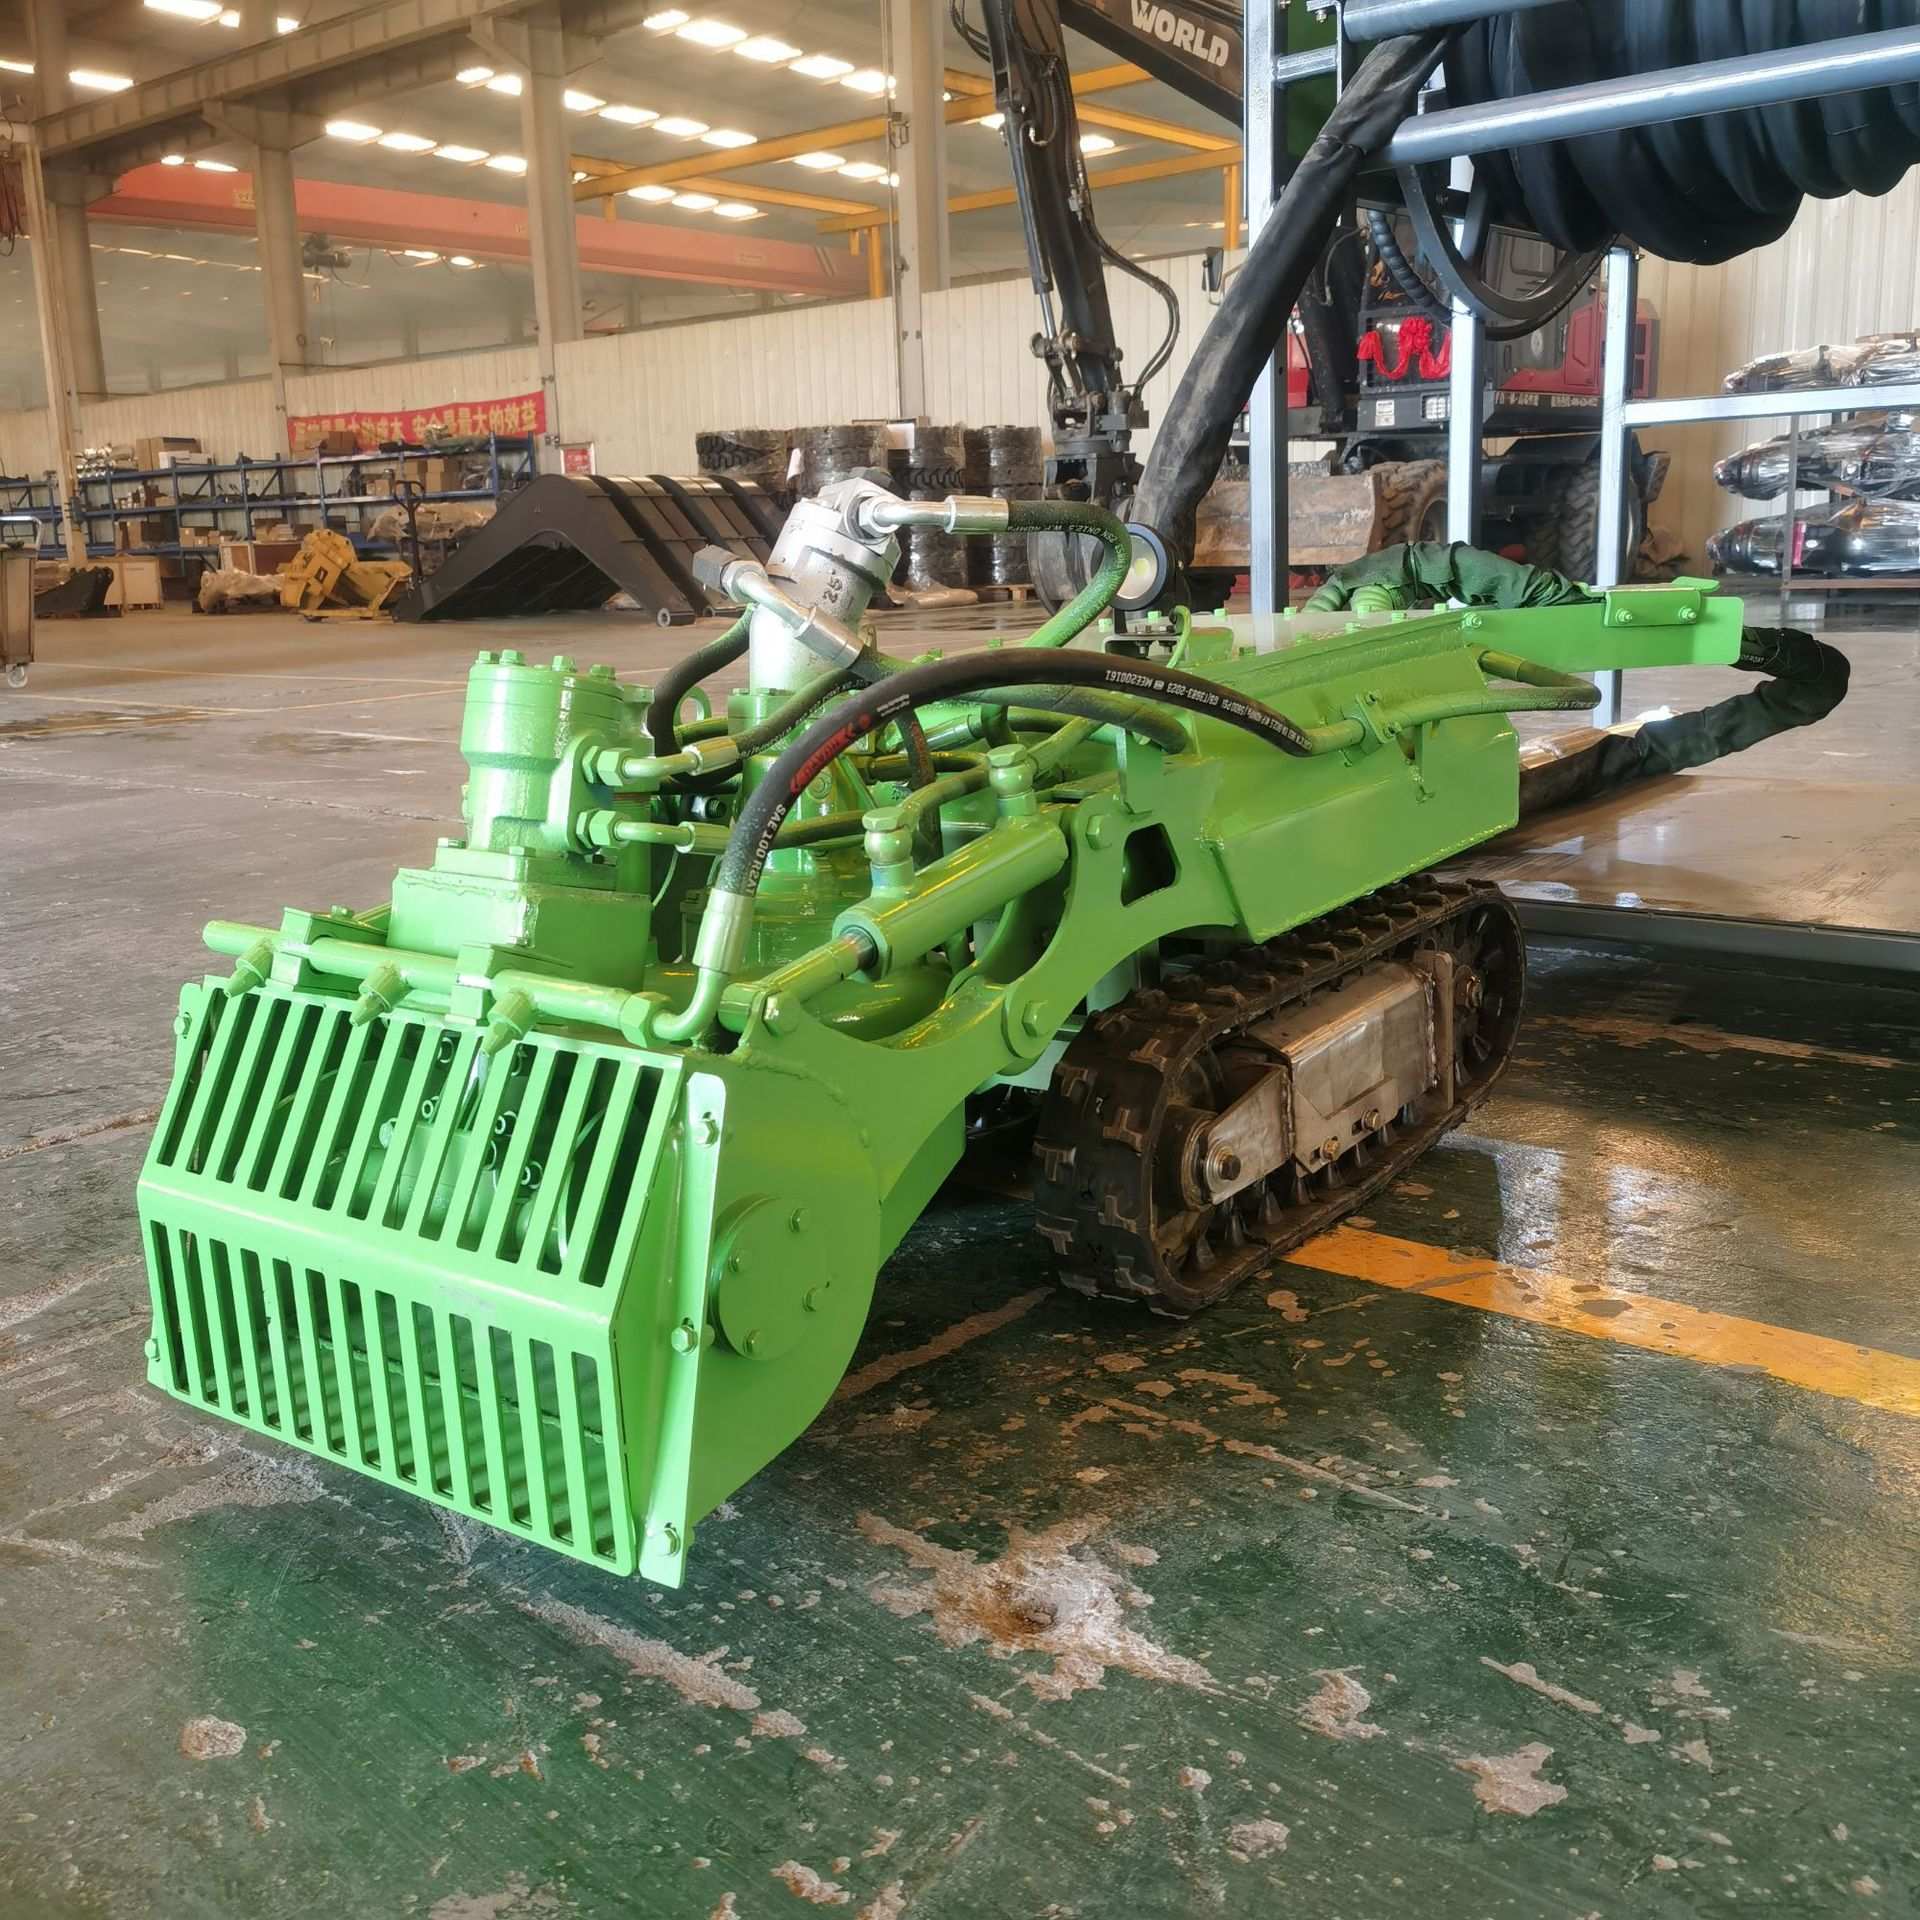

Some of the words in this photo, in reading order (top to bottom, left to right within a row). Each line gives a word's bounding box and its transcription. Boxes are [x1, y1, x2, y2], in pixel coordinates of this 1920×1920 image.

[1131, 0, 1229, 67] WORLD
[767, 804, 787, 829] SAE
[755, 832, 773, 856] 100
[746, 858, 764, 897] R2AT
